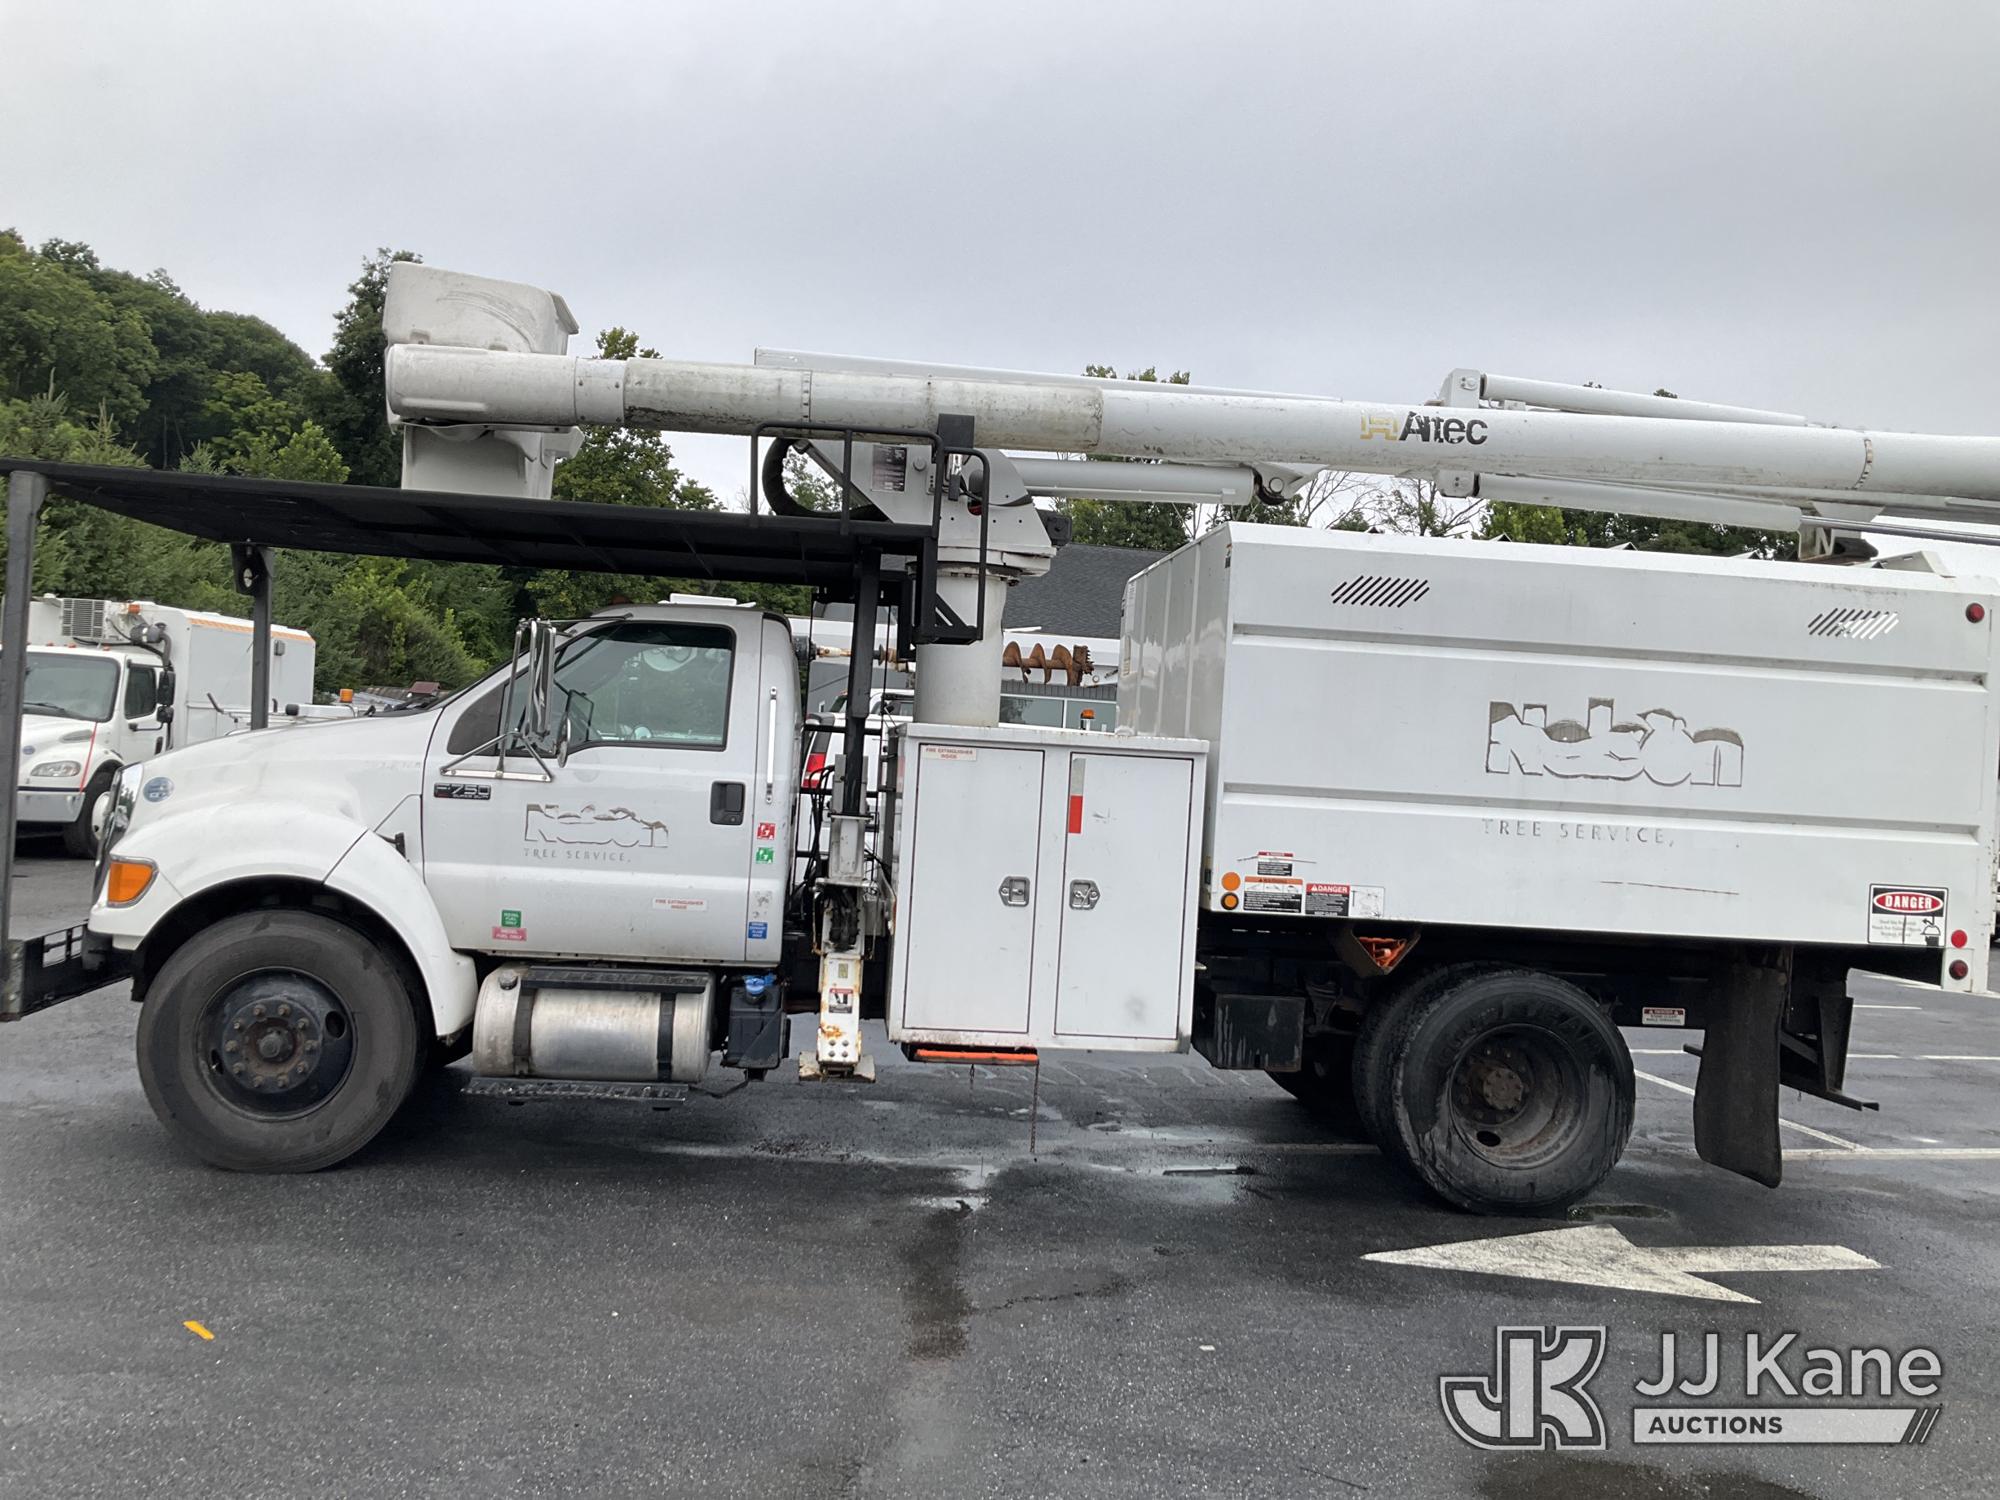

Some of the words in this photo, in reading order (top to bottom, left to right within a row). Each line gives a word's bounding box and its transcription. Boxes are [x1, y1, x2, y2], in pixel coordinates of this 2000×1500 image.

[1482, 818, 1542, 837] TREE
[1317, 885, 1348, 893] DANGER
[1885, 895, 1932, 909] DANGER
